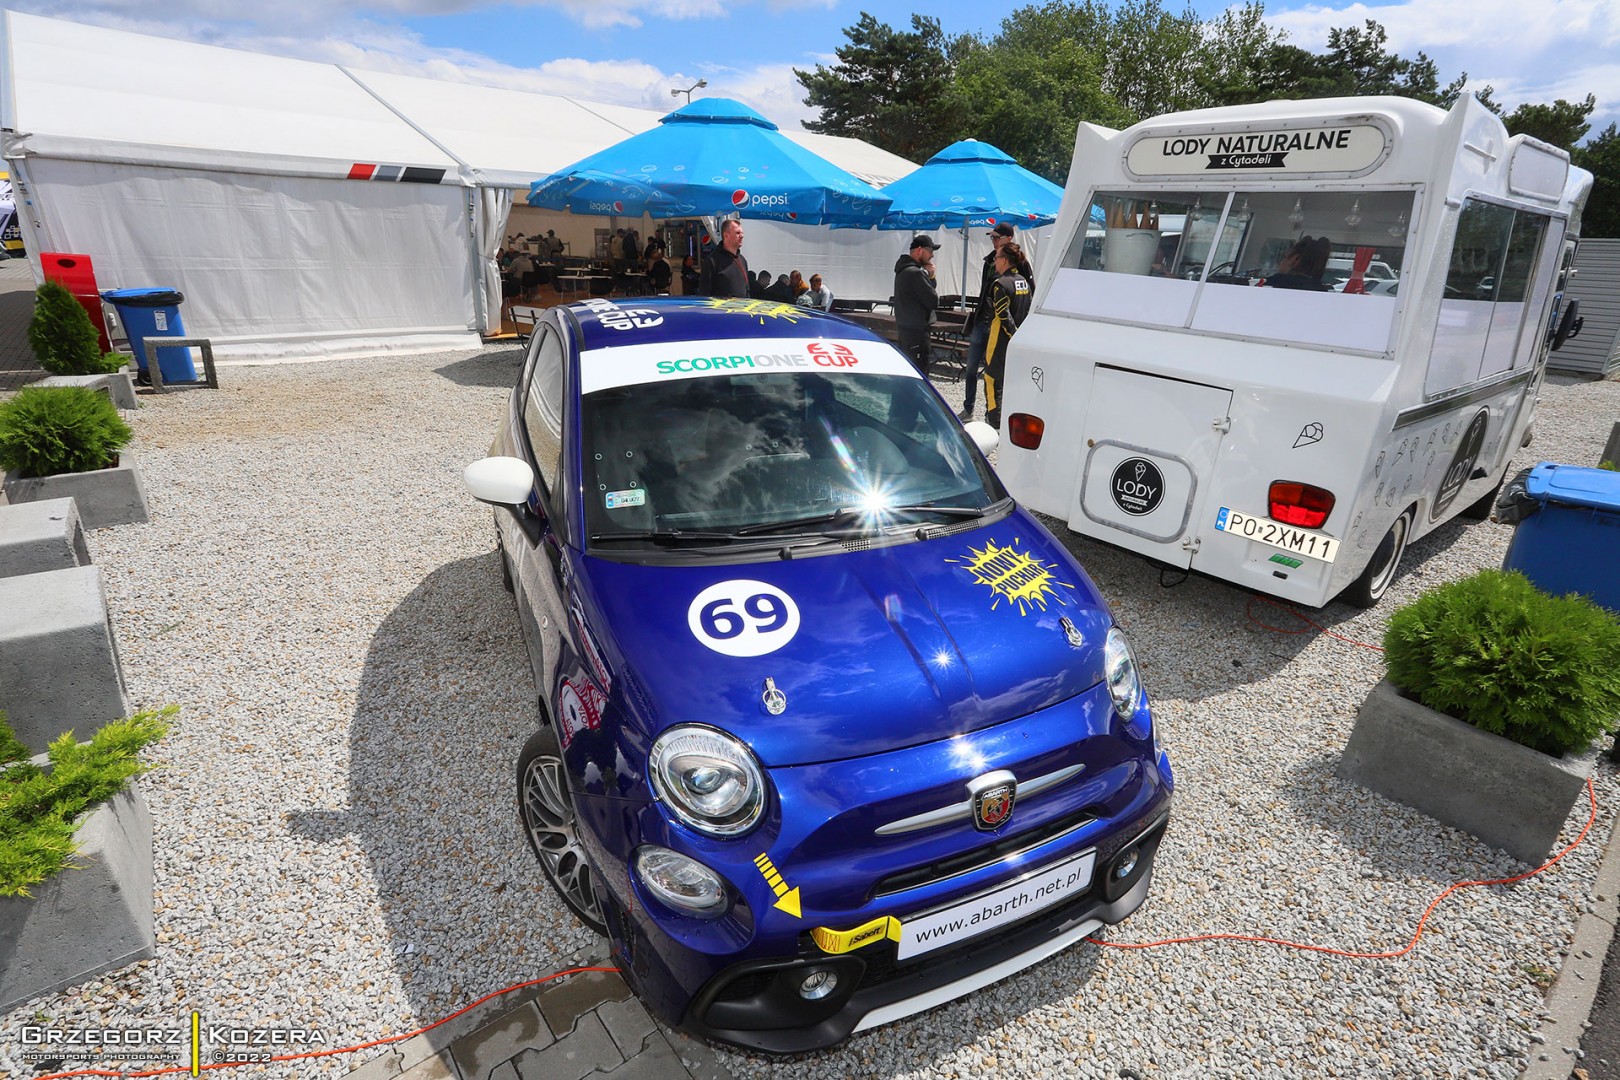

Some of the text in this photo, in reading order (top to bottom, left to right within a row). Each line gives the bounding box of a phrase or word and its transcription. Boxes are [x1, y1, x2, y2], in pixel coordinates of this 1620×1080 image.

[1163, 129, 1351, 156] LODY NATURALNE
[1229, 154, 1272, 167] Cytadeli
[752, 192, 788, 207] pepsi
[656, 354, 859, 375] SCORPIONE CUP
[1116, 478, 1157, 500] LODY
[1262, 524, 1331, 559] 2XM11
[973, 549, 1023, 583] NOWY
[995, 563, 1046, 595] PUCHAR
[700, 593, 788, 640] 69
[915, 868, 1082, 944] www.abarth.net.pl
